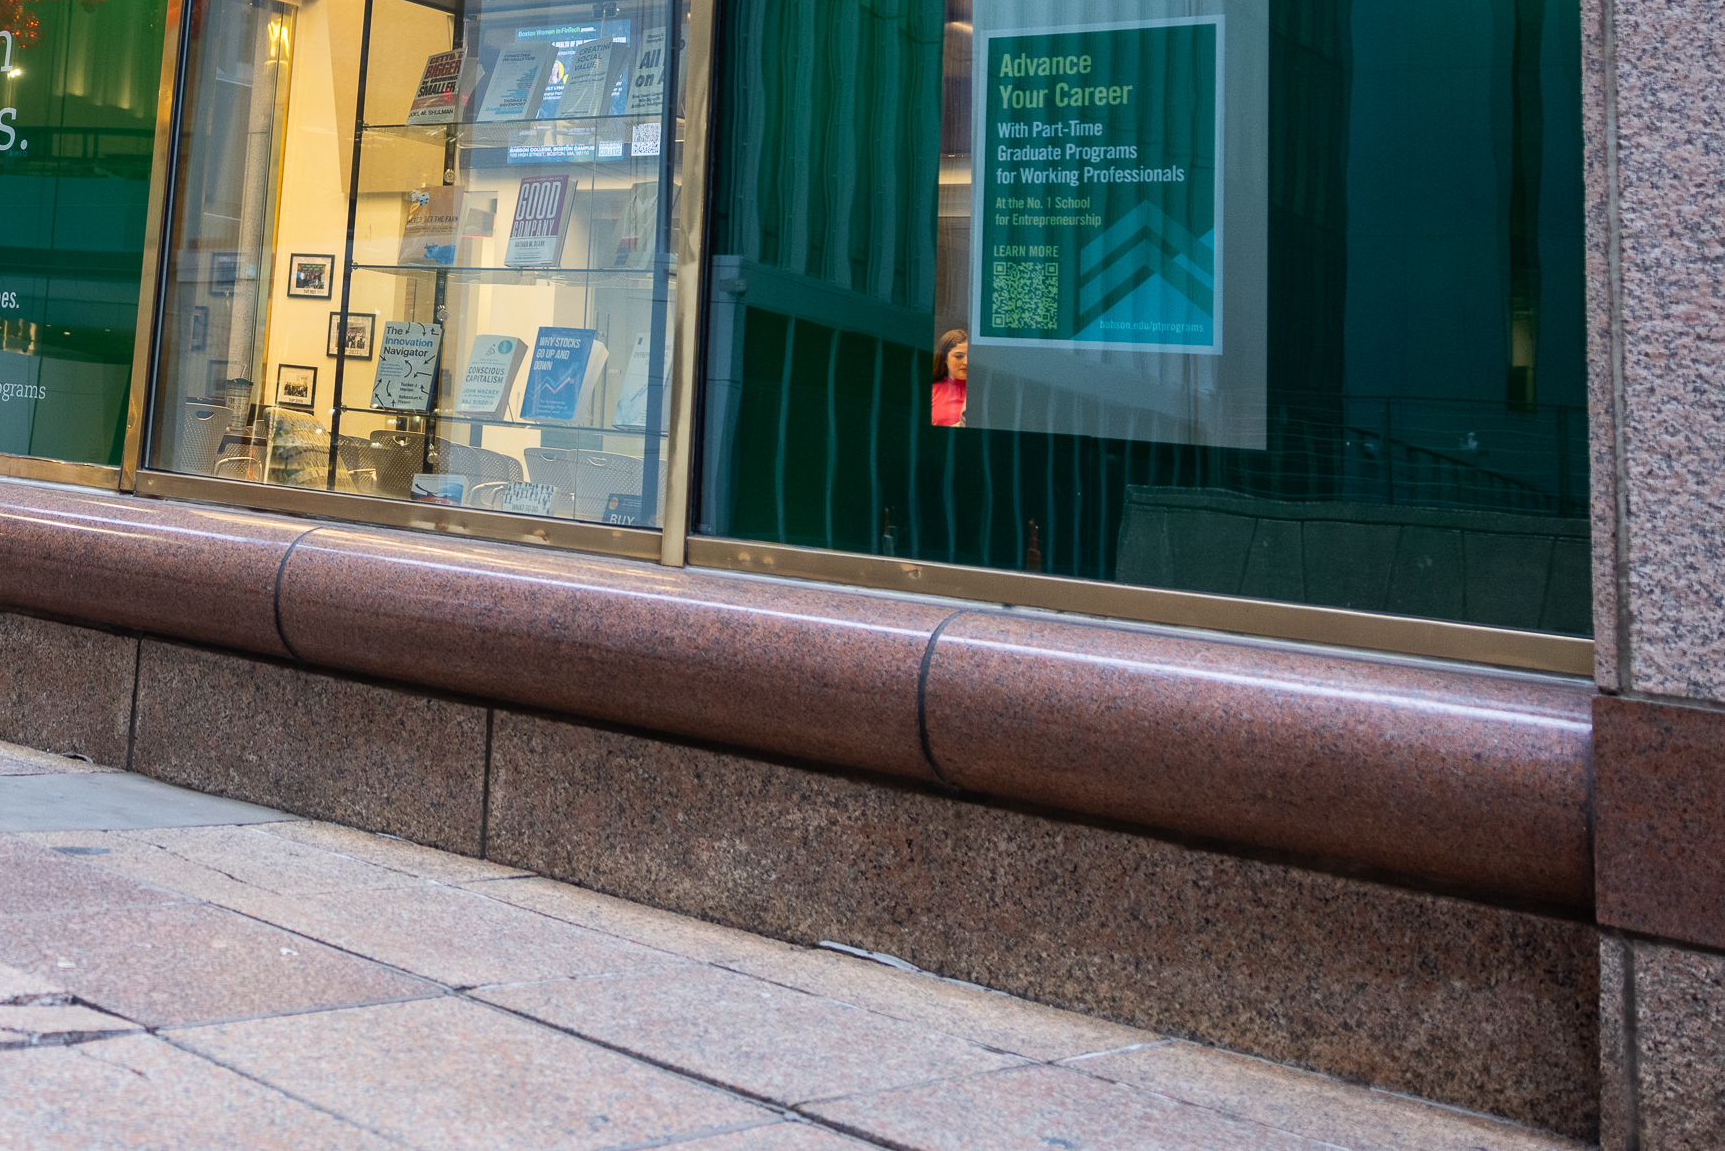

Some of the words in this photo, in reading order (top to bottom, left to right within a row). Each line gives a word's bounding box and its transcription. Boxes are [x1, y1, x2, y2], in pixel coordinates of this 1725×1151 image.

[578, 42, 613, 56] CREATING
[576, 53, 602, 64] SOCIAL
[423, 60, 462, 80] BIGGER
[999, 53, 1092, 78] Advance
[417, 81, 457, 98] SMALLER
[999, 85, 1048, 109] Your
[1055, 82, 1133, 107] Career
[998, 121, 1028, 138] With
[1033, 120, 1103, 138] Part-Time
[997, 145, 1062, 161] Graduate
[1066, 144, 1138, 163] Programs
[997, 168, 1017, 184] for
[1020, 167, 1080, 186] Working
[1083, 165, 1185, 183] Professionals
[515, 181, 562, 220] GOOD
[996, 197, 1006, 209] At
[1008, 197, 1024, 209] the
[1027, 197, 1043, 209] No.
[1047, 196, 1051, 208] 1
[1055, 196, 1090, 209] School
[995, 213, 1010, 225] for
[1012, 213, 1102, 228] Entrepreneurship
[511, 219, 555, 238] COMPANY
[993, 245, 1026, 257] LEARN
[1029, 245, 1059, 257] MORE
[386, 326, 403, 335] The
[1100, 320, 1204, 333] babson.edu/ptprograms
[385, 336, 433, 348] Innovation
[538, 336, 555, 347] WHY
[555, 337, 581, 348] STOCKS
[383, 347, 428, 358] Navigator
[536, 348, 545, 359] GO
[545, 348, 555, 359] UP
[555, 350, 570, 360] AND
[468, 366, 505, 375] CONSCIOUS
[534, 360, 553, 371] DOWN
[465, 374, 504, 384] CAPITALISM
[511, 504, 525, 512] WHAT
[525, 504, 532, 512] TO
[532, 505, 539, 513] DO
